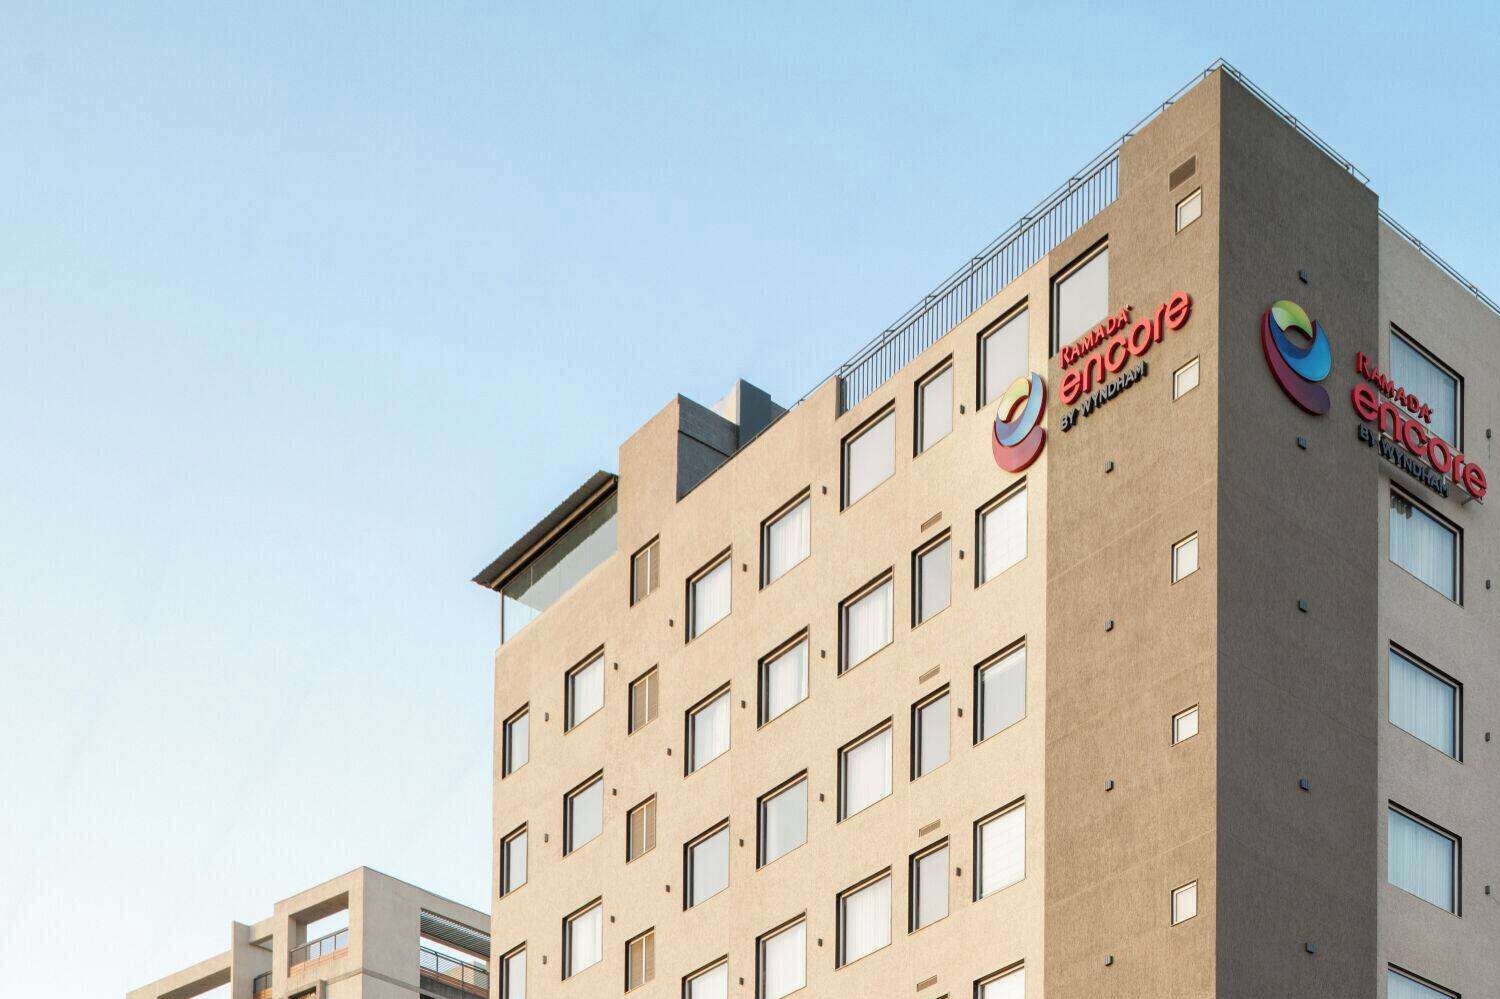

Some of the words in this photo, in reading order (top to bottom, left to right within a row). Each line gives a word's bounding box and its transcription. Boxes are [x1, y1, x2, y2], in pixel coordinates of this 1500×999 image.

[1059, 290, 1192, 405] encore
[1060, 308, 1129, 370] RAMADA
[1061, 408, 1079, 432] BY
[1080, 361, 1148, 417] WYNDHAM
[1356, 351, 1433, 424] RAMADA
[1351, 383, 1488, 499] encore
[1358, 423, 1376, 448] BY
[1379, 436, 1450, 498] WYNDHAM
